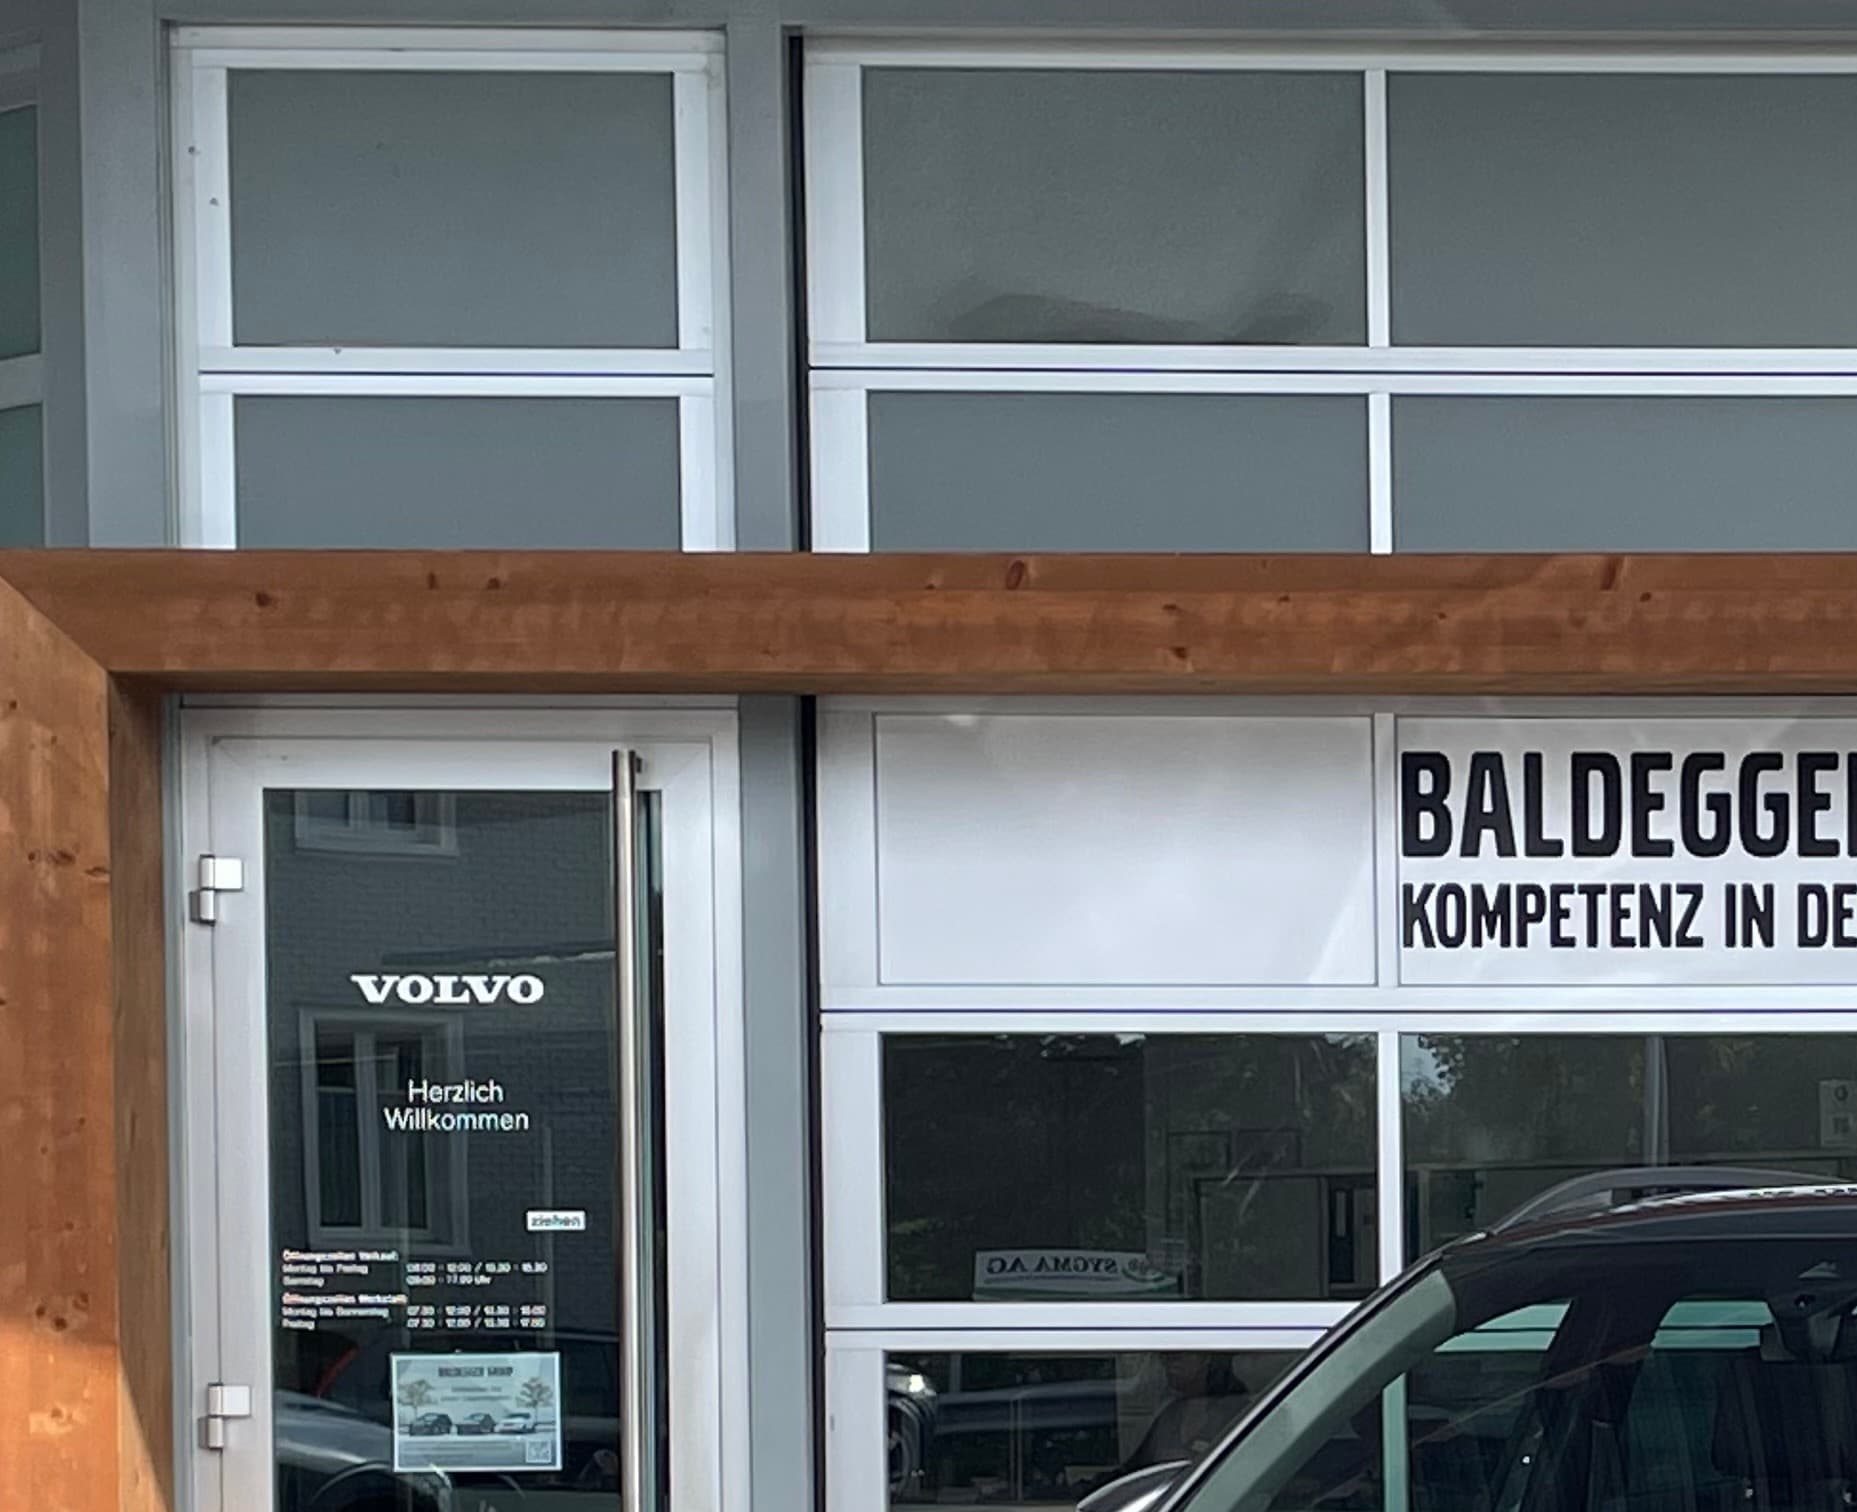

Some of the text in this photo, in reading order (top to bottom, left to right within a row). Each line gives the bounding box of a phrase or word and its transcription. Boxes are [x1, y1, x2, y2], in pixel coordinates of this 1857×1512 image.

[1402, 883, 1704, 949] KOMPETENZ
[1725, 883, 1776, 949] IN
[351, 975, 545, 1004] VOLVO
[408, 1079, 504, 1104] Herzlich
[383, 1107, 530, 1131] Willkommen
